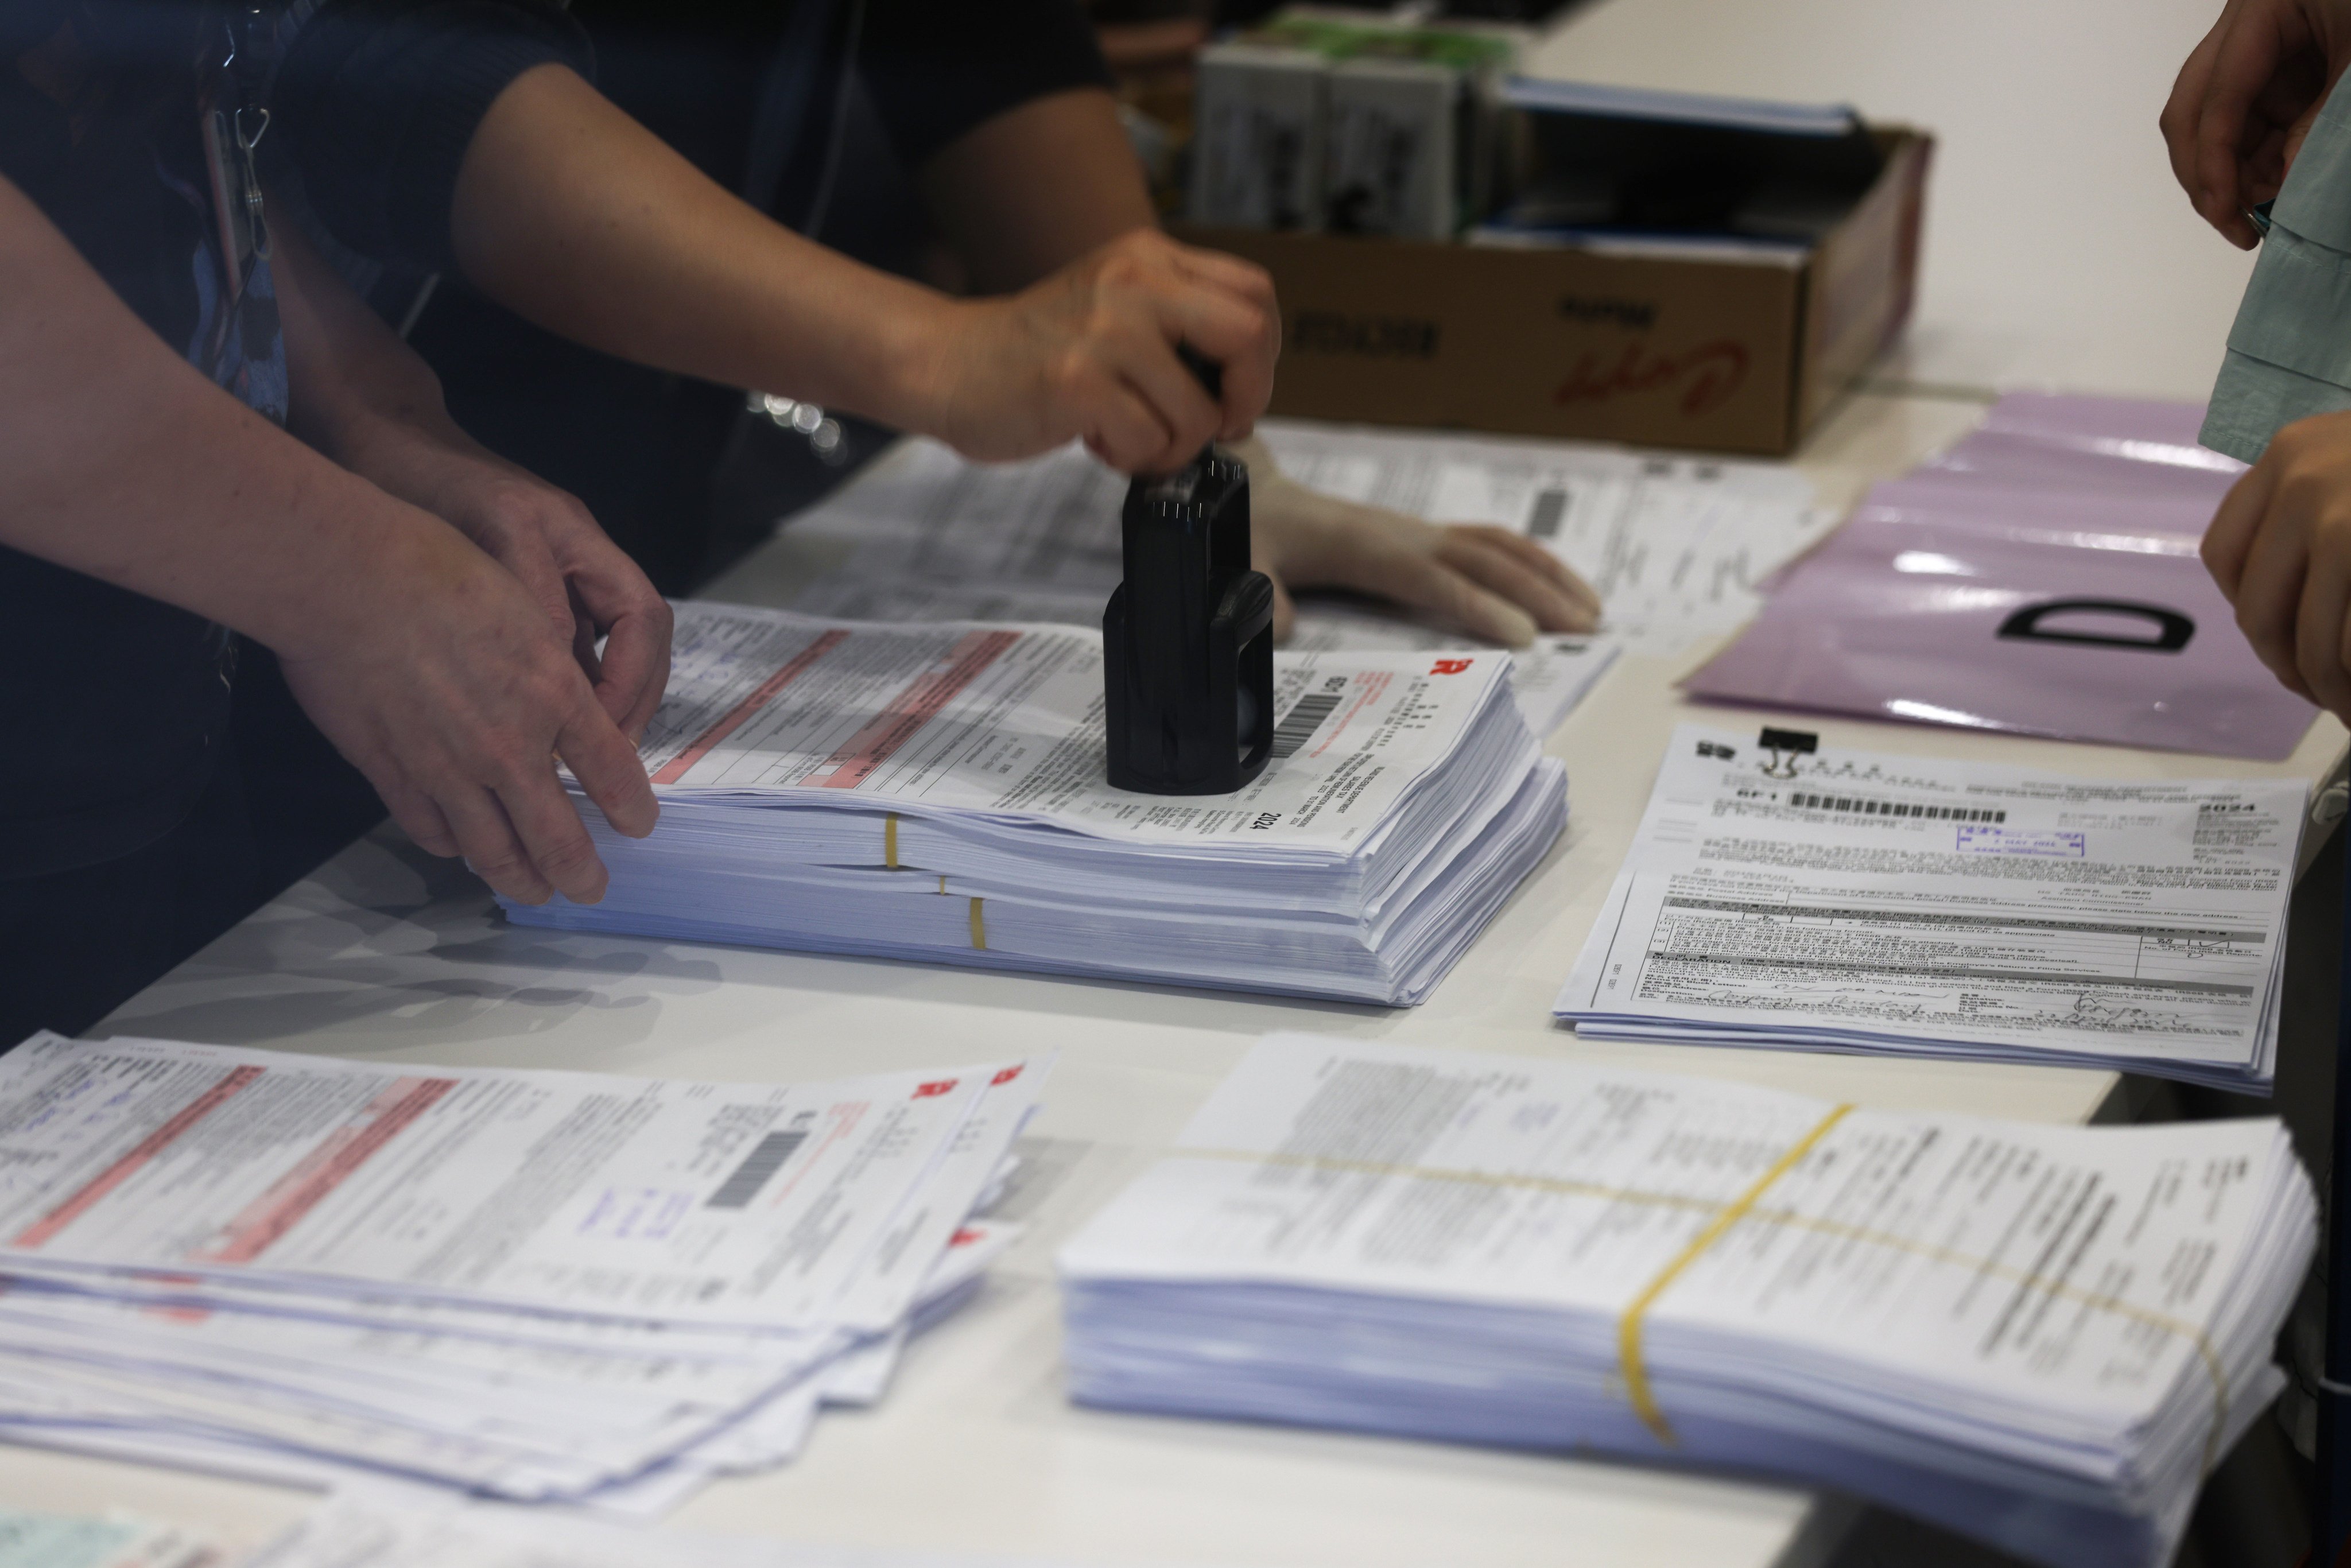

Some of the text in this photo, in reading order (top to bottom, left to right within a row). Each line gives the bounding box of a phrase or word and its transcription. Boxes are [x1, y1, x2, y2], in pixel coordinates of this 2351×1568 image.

[1993, 596, 2196, 655] D
[1317, 785, 1328, 793] 2023
[1343, 776, 1360, 791] SALARIES
[1355, 776, 1373, 790] REVENUE
[1318, 782, 1341, 805] REMUNERATION
[1297, 804, 1310, 814] MARCH
[1337, 790, 1360, 813] DEPARTMENT
[1250, 812, 1282, 830] 2024
[1298, 812, 1315, 827] PENSIONS
[1651, 955, 1731, 964] DECLARATION
